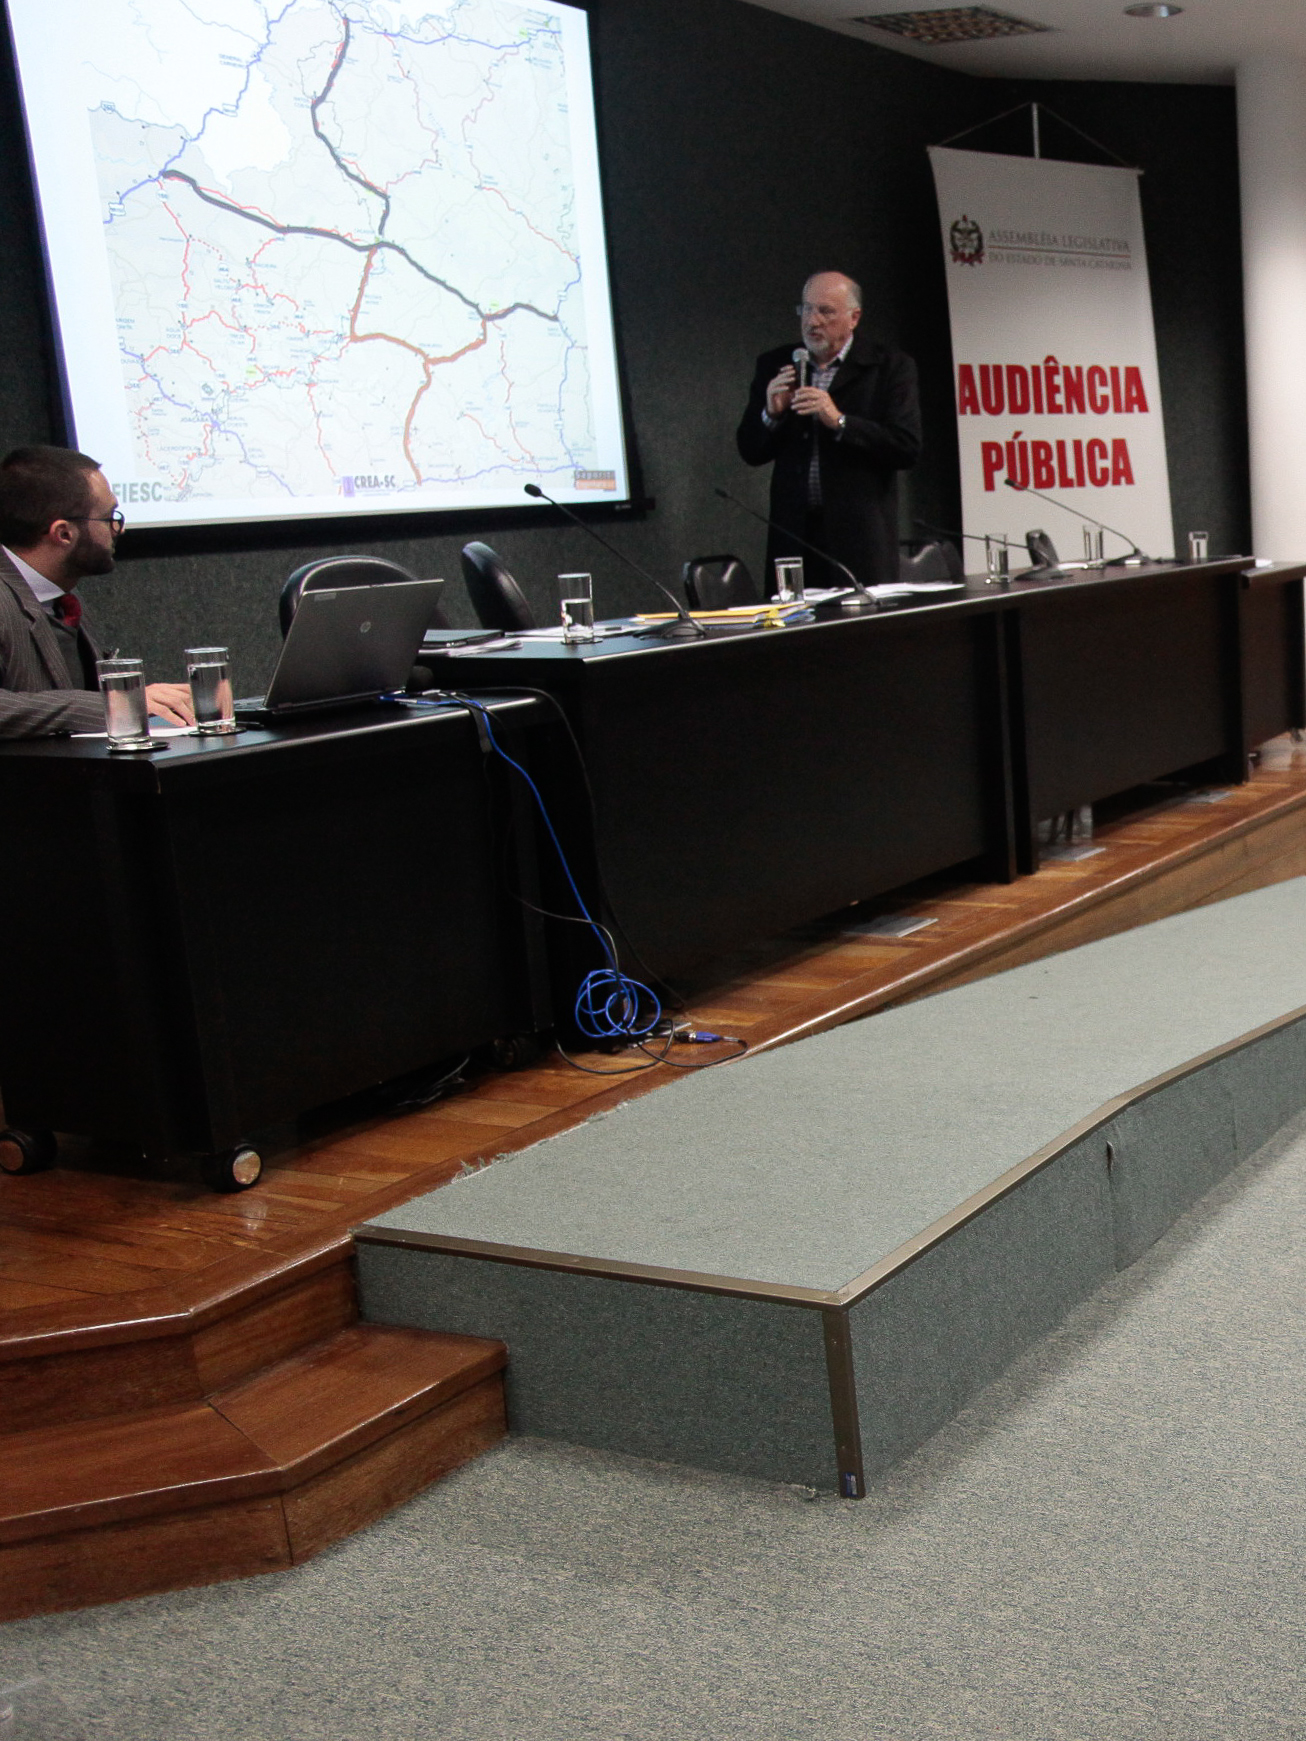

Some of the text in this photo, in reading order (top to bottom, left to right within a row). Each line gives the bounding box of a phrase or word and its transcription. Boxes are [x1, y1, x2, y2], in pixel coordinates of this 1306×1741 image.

[1061, 235, 1131, 252] LEGISLATIVA
[988, 251, 1004, 263] DO
[1006, 253, 1042, 265] ESTADO
[1059, 256, 1087, 268] SANTA
[1088, 258, 1132, 271] CATARINA
[959, 355, 1149, 415] AUDIÊNCIA
[981, 431, 1135, 492] PÚBLICA
[354, 475, 396, 489] CREA-SC
